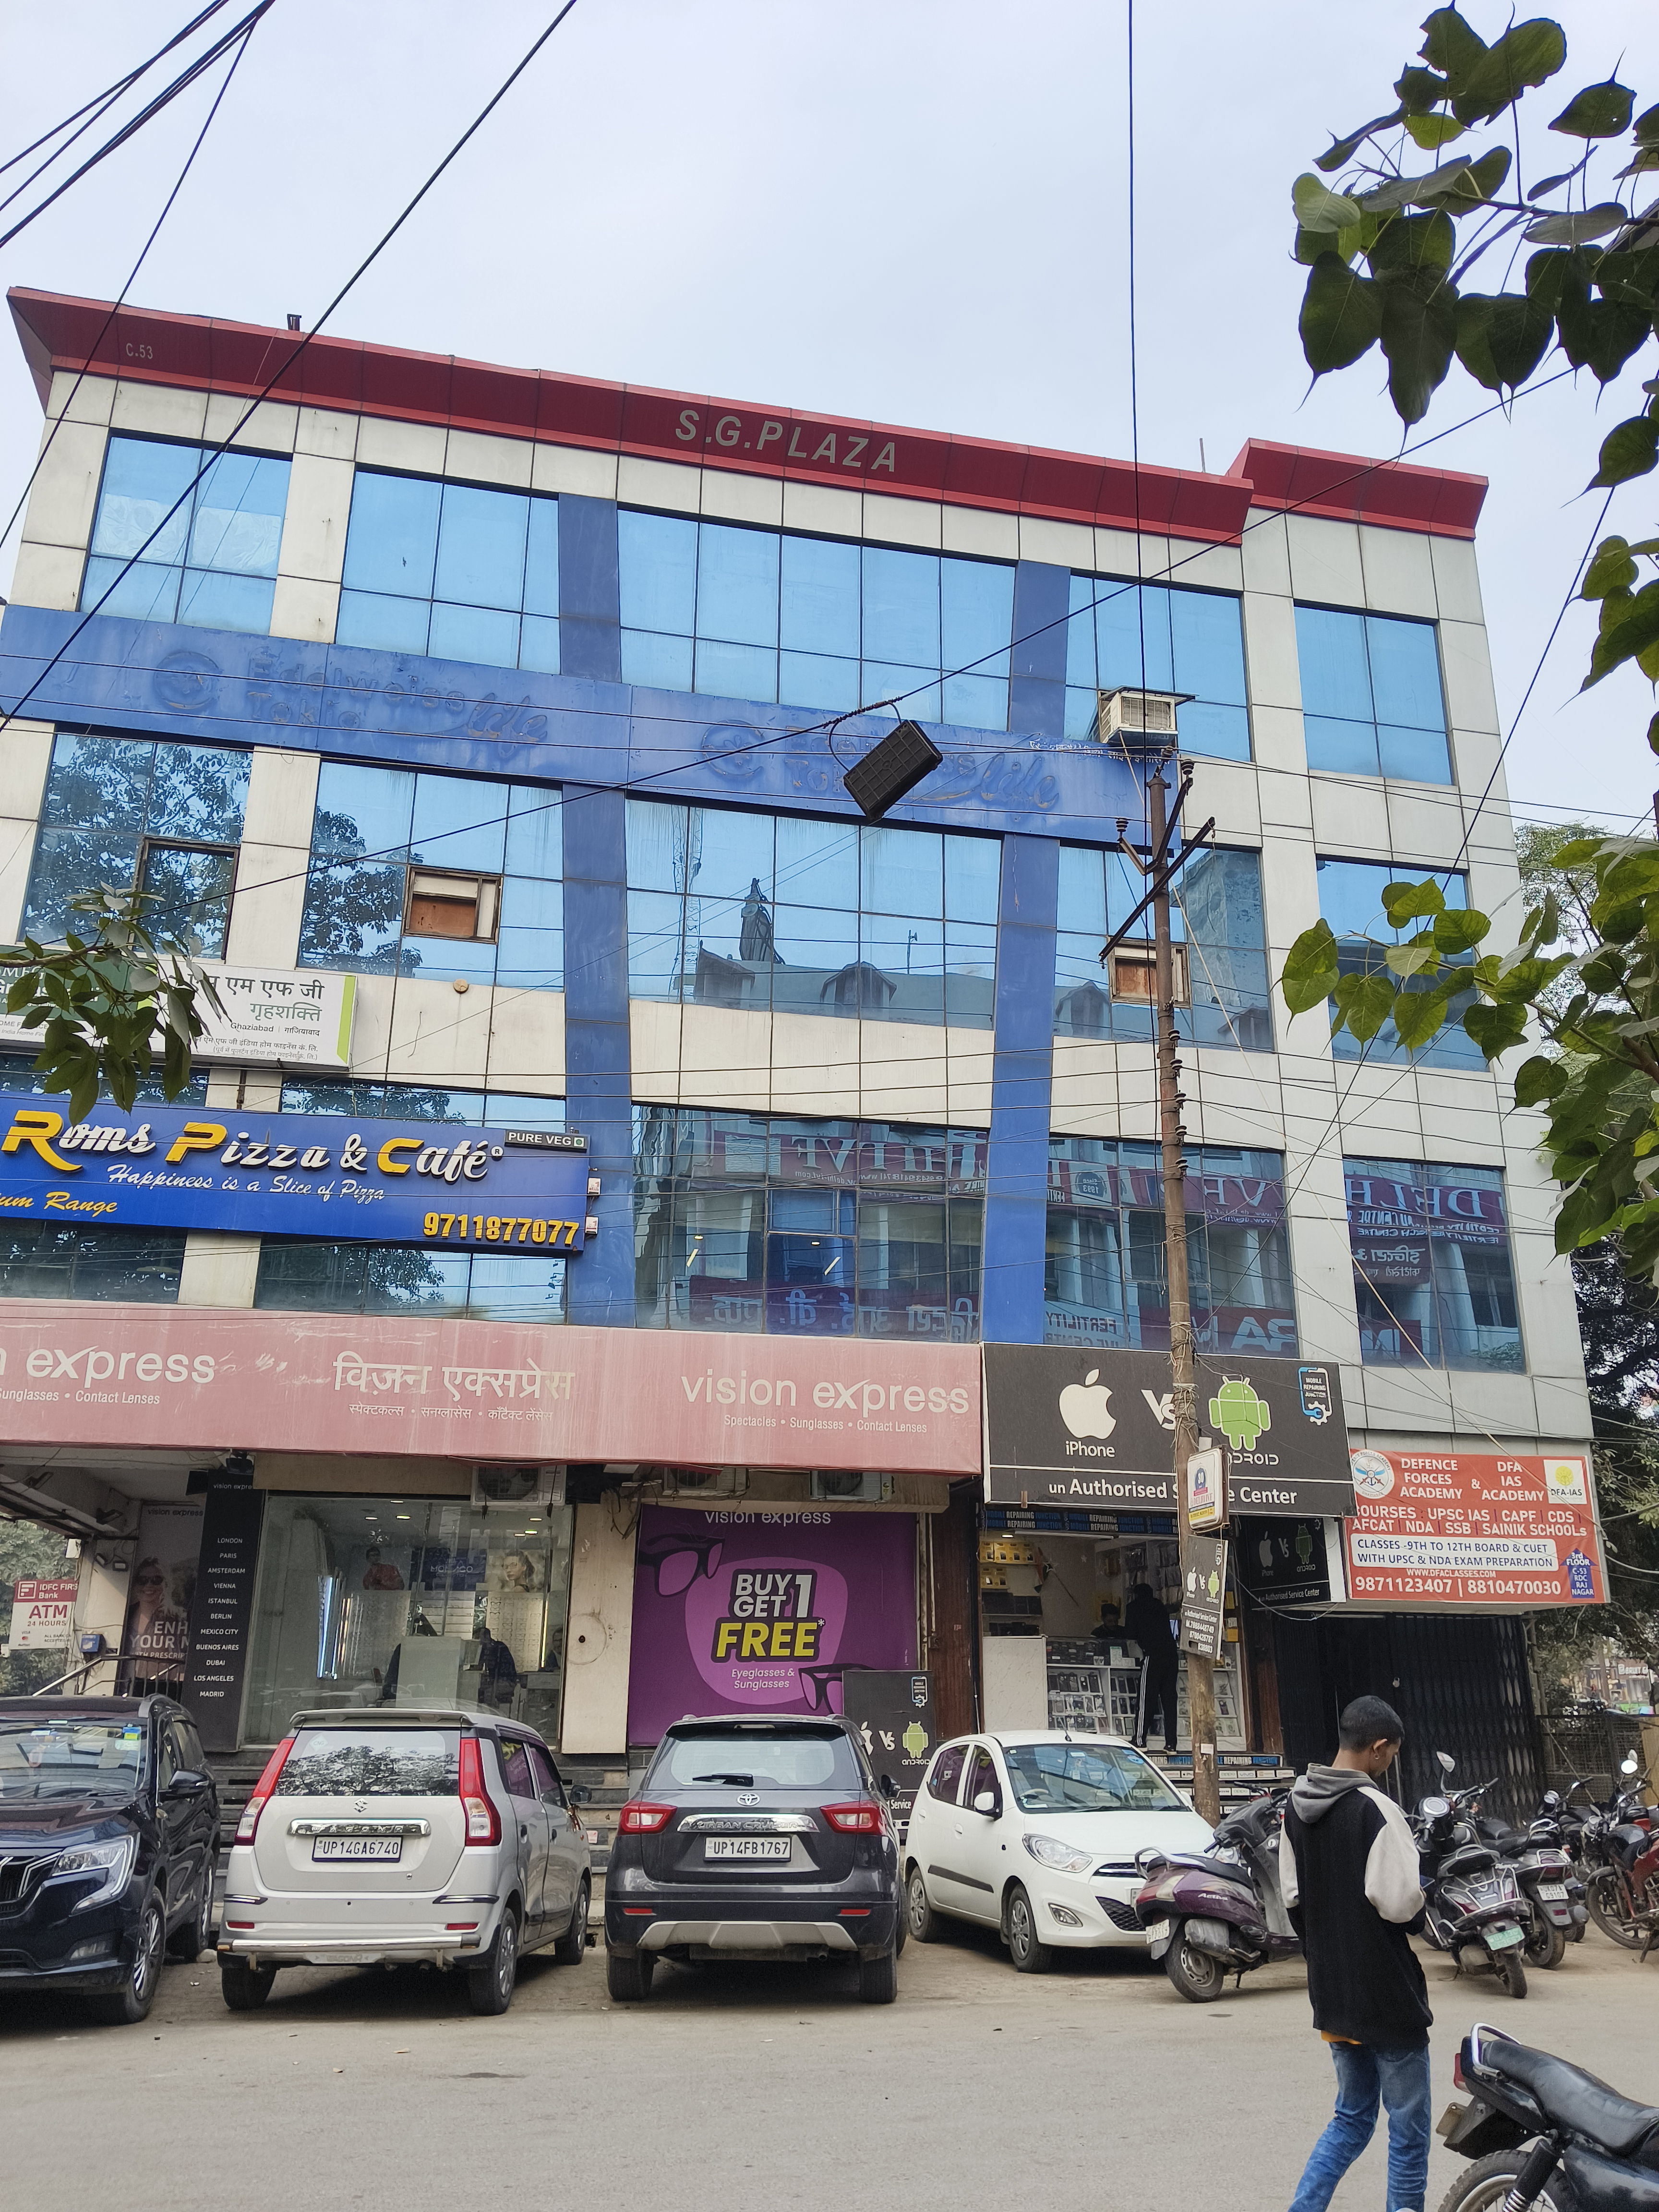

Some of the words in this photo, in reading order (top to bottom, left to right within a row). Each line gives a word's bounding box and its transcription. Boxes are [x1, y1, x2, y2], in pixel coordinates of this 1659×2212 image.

[126, 343, 153, 360] C.53
[225, 977, 255, 995] एम
[260, 980, 294, 998] एफ
[300, 979, 325, 999] जी
[250, 1002, 322, 1021] गृहशक्ति
[231, 1023, 274, 1032] Ghaziabad
[508, 1131, 542, 1144] PURE
[546, 1135, 571, 1146] VEG
[1, 1110, 156, 1171] Roms
[165, 1122, 330, 1169] Pizza
[340, 1133, 368, 1172] &
[377, 1138, 489, 1183] Café
[107, 1164, 213, 1190] Happiness
[222, 1176, 240, 1190] is
[247, 1181, 261, 1191] a
[270, 1175, 312, 1196] Slice
[317, 1180, 334, 1202] of
[340, 1179, 385, 1204] Pizza
[44, 1191, 118, 1217] Range
[423, 1212, 579, 1246] 9711877077
[26, 1346, 216, 1388] express
[442, 1357, 575, 1402] एक्सप्रेस
[75, 1390, 119, 1404] Contact
[122, 1391, 160, 1405] Lenses
[681, 1369, 796, 1407] vision
[813, 1379, 969, 1418] express
[724, 1415, 776, 1429] Spectacles
[790, 1417, 843, 1431] Sunglasses
[857, 1419, 893, 1432] Contact
[896, 1421, 927, 1433] Lenses
[1065, 1441, 1116, 1458] iPhone
[1401, 1458, 1458, 1471] DEFENCE
[1497, 1461, 1523, 1473] DFA
[1405, 1473, 1452, 1485] FORCES
[1471, 1479, 1480, 1490] &
[1501, 1476, 1522, 1487] IAS
[1049, 1483, 1066, 1494] un
[1069, 1478, 1168, 1500] Authorised
[1240, 1487, 1298, 1504] Center
[1400, 1487, 1462, 1499] ACADEMY
[1482, 1490, 1544, 1502] ACADEMY
[705, 1510, 755, 1524] vision
[761, 1512, 831, 1527] express
[1428, 1508, 1465, 1521] UPSC
[1468, 1509, 1490, 1521] IAS
[1502, 1510, 1537, 1523] CAPF
[1548, 1511, 1574, 1523] CDS
[1353, 1518, 1395, 1532] AFCAT
[1406, 1520, 1434, 1533] NDA
[1445, 1522, 1472, 1534] SSB
[1483, 1523, 1525, 1536] SAINIK
[1530, 1524, 1587, 1536] SCHOOLs
[1358, 1539, 1400, 1550] CLASSES
[1430, 1542, 1443, 1551] TO
[1447, 1542, 1471, 1552] 12TH
[1475, 1543, 1509, 1552] BOARD
[1513, 1543, 1521, 1553] &
[1524, 1544, 1548, 1553] CUET
[1358, 1553, 1385, 1563] WITH
[1389, 1554, 1414, 1564] UPSC
[1418, 1555, 1426, 1564] &
[1429, 1556, 1451, 1565] NDA
[1455, 1556, 1483, 1566] EXAM
[1486, 1557, 1553, 1568] PREPARATION
[1407, 1568, 1496, 1578] WWW.DFACLASSES.COM
[1356, 1576, 1452, 1593] 9871123407
[1467, 1579, 1561, 1595] 8810470030
[735, 1574, 792, 1595] BUY
[795, 1575, 812, 1618] 1
[1288, 1590, 1304, 1598] Service
[29, 1605, 67, 1619] ATM
[733, 1596, 786, 1617] GET
[130, 1635, 175, 1648] YOUR
[732, 1668, 785, 1679] Eyeglasses
[788, 1669, 795, 1677] &
[733, 1680, 790, 1691] Sunglasses
[1224, 1756, 1251, 1765] REPAIRING
[891, 1799, 911, 1809] Service
[323, 1841, 399, 1854] UP14GA6740
[714, 1841, 788, 1854] UP14FB1767
